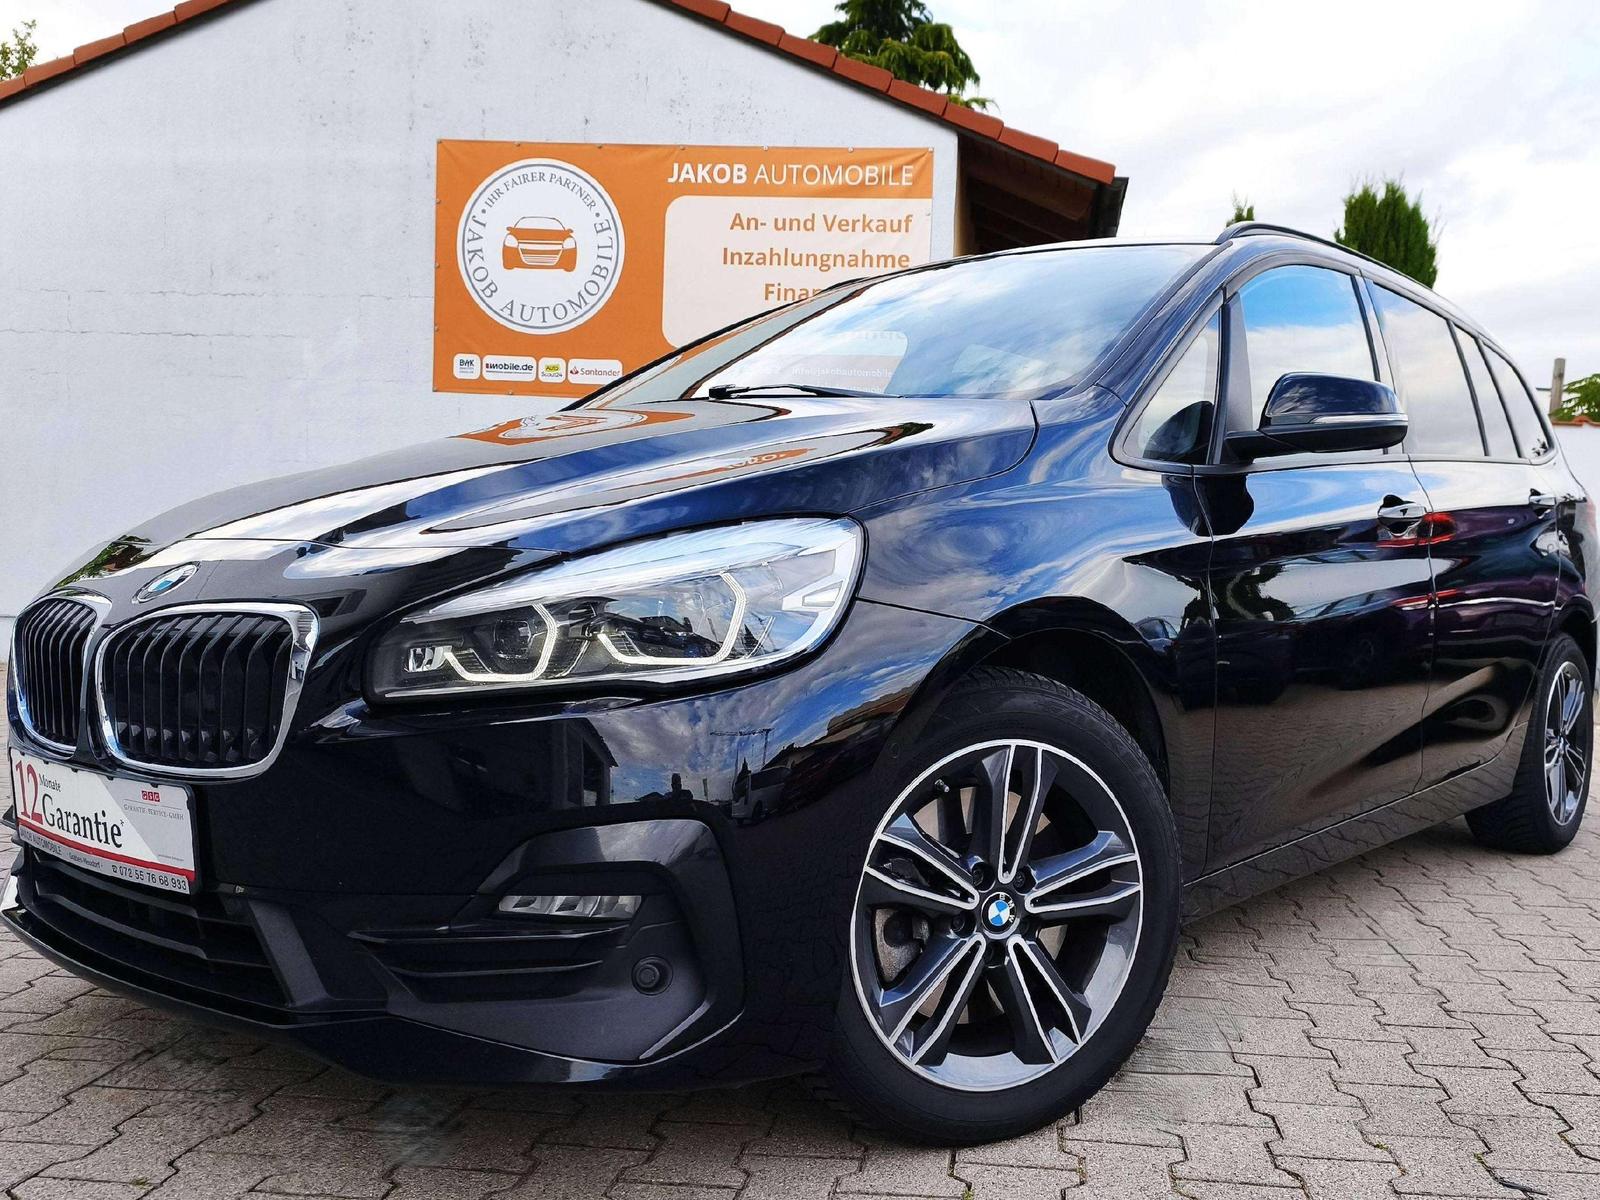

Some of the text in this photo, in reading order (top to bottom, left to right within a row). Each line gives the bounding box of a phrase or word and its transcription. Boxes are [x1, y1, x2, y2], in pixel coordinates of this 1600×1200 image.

[667, 162, 914, 186] JAKOB AUTOMOBILE
[485, 171, 597, 212] IHR FAIRER PARTNER
[729, 212, 913, 234] An- und Verkauf
[467, 215, 614, 324] JAKOB AUTOMOBILE
[722, 247, 911, 273] Inzahlungnahme
[579, 367, 621, 378] Santander
[15, 760, 43, 825] 12
[119, 866, 187, 891] 072 55 76 68 933
